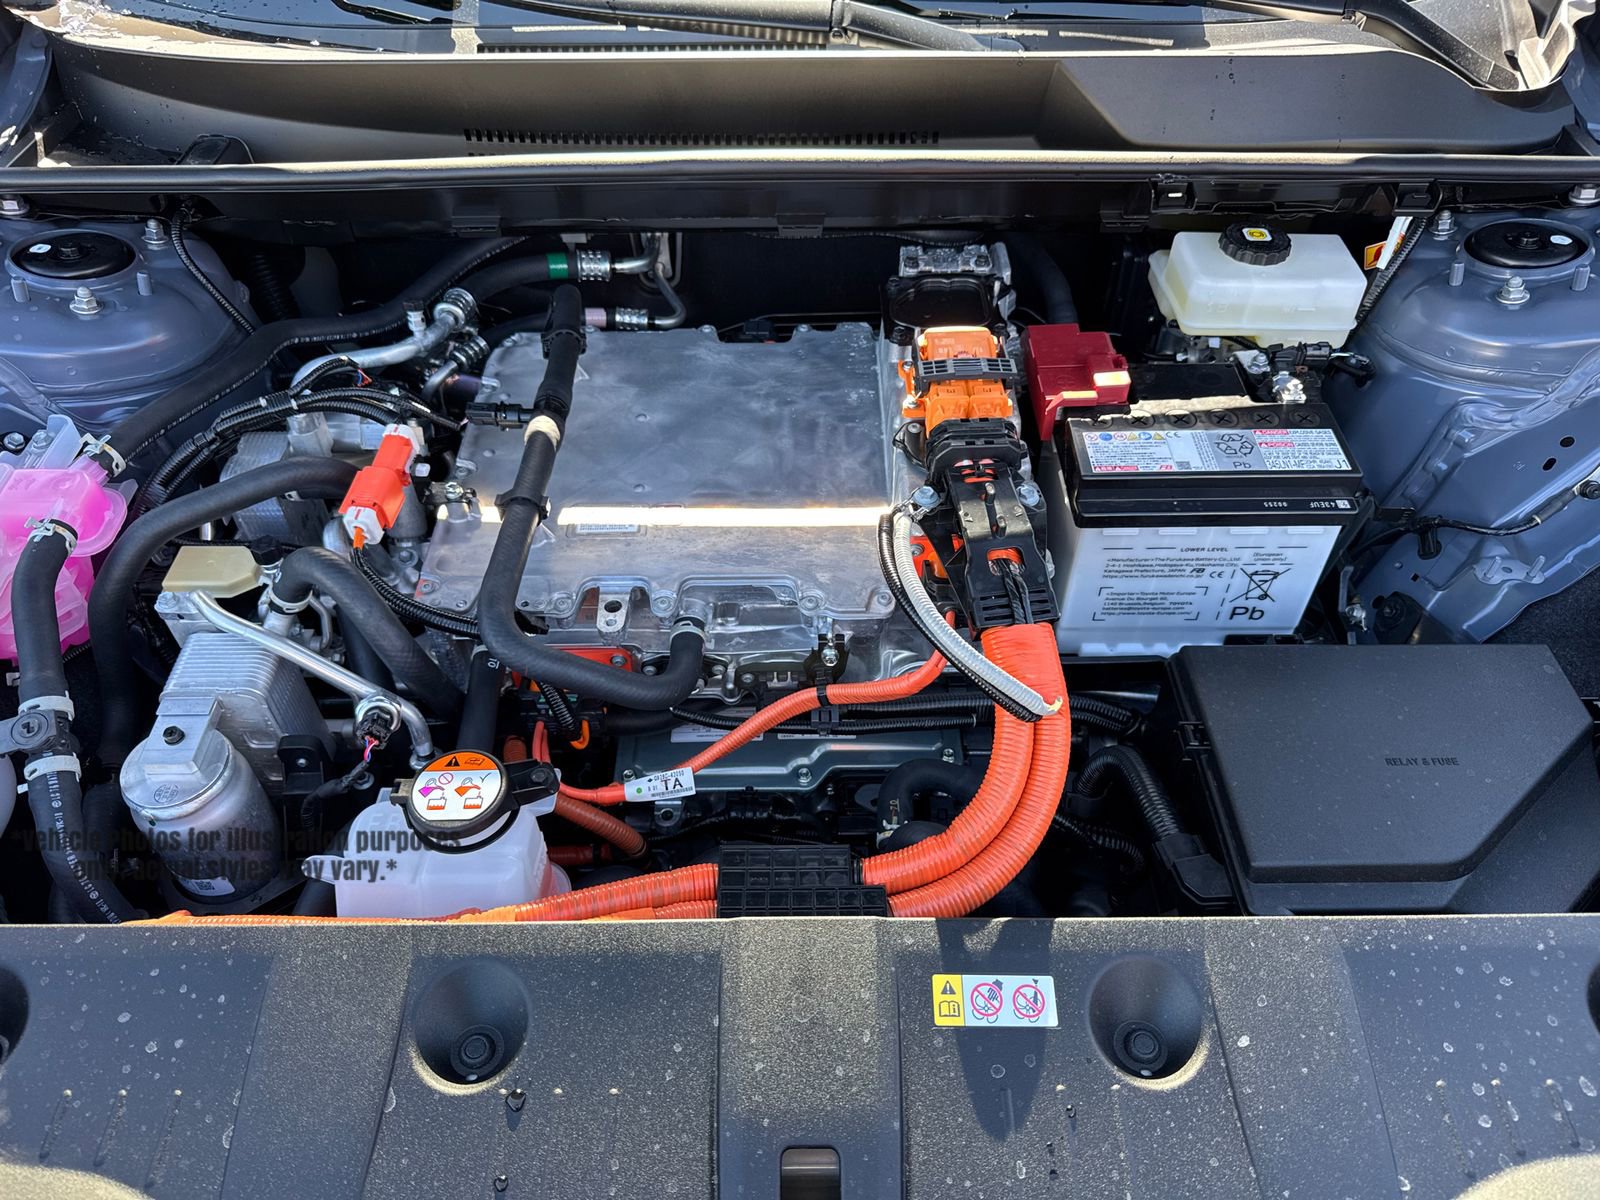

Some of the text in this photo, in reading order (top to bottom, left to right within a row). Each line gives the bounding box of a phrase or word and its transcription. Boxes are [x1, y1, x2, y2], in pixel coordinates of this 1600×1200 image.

[1229, 606, 1265, 620] Pb
[1384, 757, 1460, 767] RELAY & FUSE
[660, 777, 684, 791] TA
